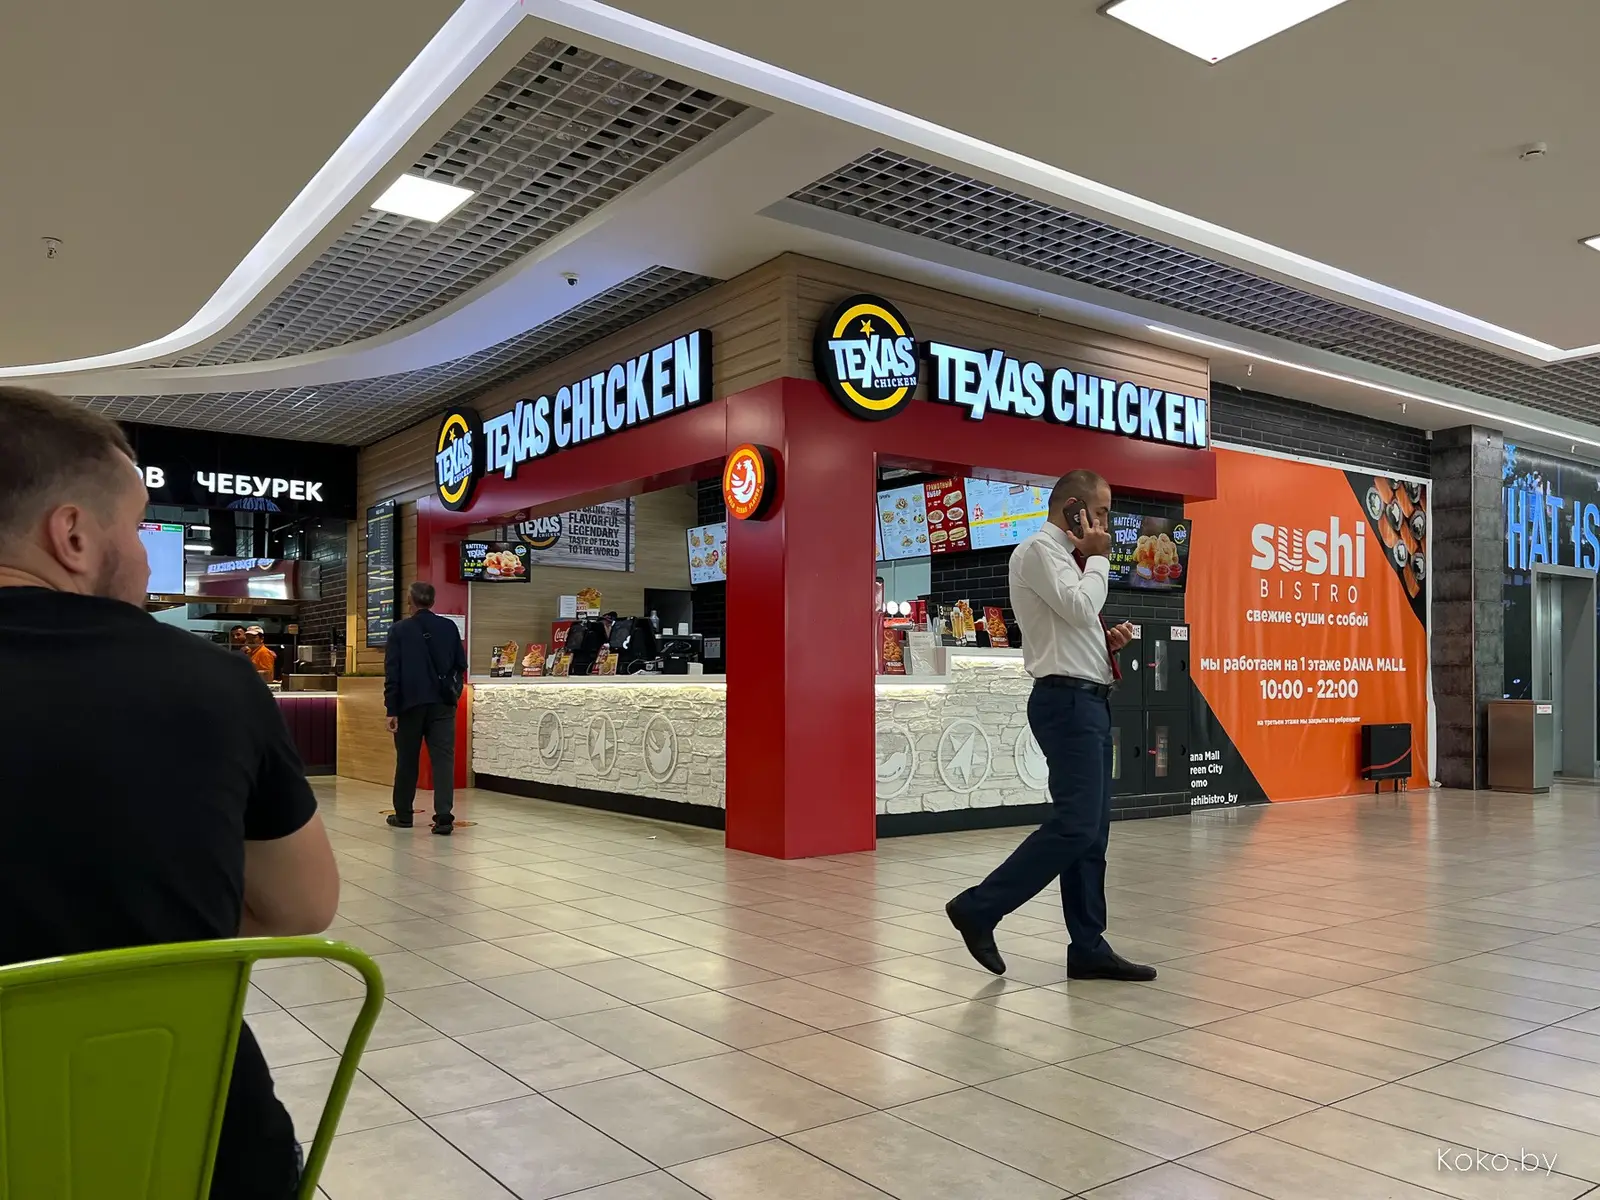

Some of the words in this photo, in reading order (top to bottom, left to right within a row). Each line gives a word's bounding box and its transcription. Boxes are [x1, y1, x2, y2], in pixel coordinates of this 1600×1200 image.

[828, 335, 915, 389] TEXAS
[874, 375, 917, 388] CHICKEN
[930, 342, 1044, 420] TEXAS
[1051, 368, 1207, 448] CHICKEN
[483, 395, 550, 479] TEXAS
[554, 331, 700, 448] CHICKEN
[436, 432, 472, 486] TEXAS
[134, 465, 166, 488] В
[196, 470, 323, 502] ЧЕБУРЕК
[520, 516, 560, 538] TEXAS
[568, 513, 620, 527] FLAVORFUL
[568, 524, 620, 538] LEGENDARY
[1115, 528, 1138, 544] TEXAS
[569, 536, 589, 546] TASTE
[590, 537, 598, 545] OF
[599, 538, 620, 547] TEXAS
[569, 545, 578, 553] TO
[579, 546, 593, 555] THE
[594, 547, 620, 557] WORLD
[1251, 516, 1366, 578] sushi
[1260, 578, 1358, 604] BISTRO
[1246, 609, 1292, 623] свежие
[1295, 613, 1325, 626] суши
[1328, 615, 1334, 625] с
[1337, 612, 1369, 627] собой
[1201, 658, 1221, 671] мы
[1223, 656, 1281, 675] работаем
[1284, 658, 1298, 671] на
[1300, 657, 1305, 671] 1
[1308, 659, 1341, 672] этаже
[1343, 657, 1374, 672] DANA
[1376, 657, 1407, 673] MALL
[1260, 679, 1304, 700] 10:00
[1316, 679, 1359, 699] 22:00
[1190, 753, 1203, 761] ana
[1204, 750, 1220, 760] Mall
[1190, 766, 1207, 775] reen
[1208, 764, 1223, 774] City
[1191, 779, 1208, 788] omo
